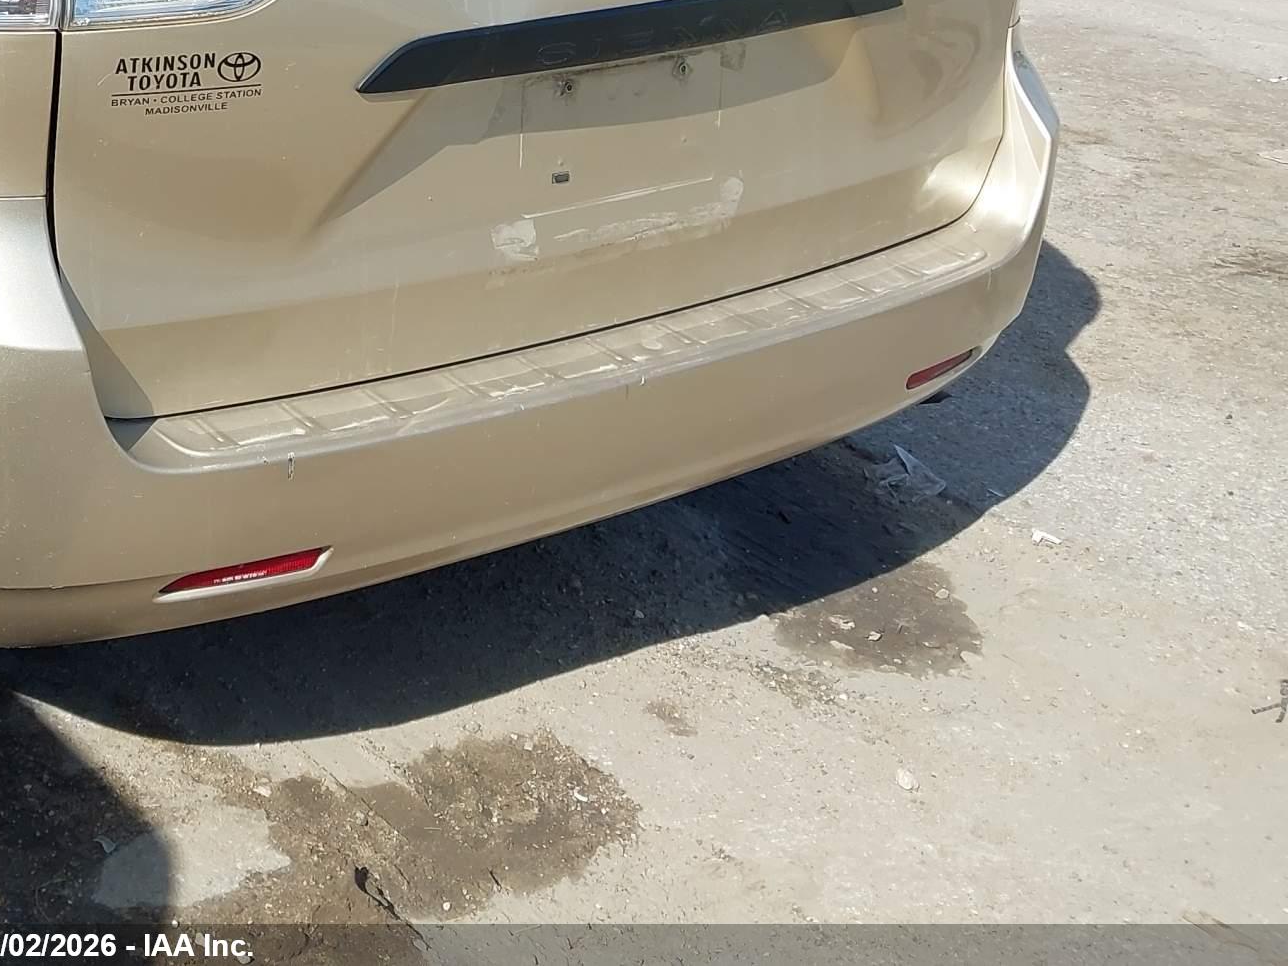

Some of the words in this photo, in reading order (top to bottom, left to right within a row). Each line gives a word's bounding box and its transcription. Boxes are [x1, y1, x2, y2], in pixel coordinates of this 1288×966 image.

[114, 52, 216, 75] ATKINSON
[127, 71, 202, 92] TOYOTA
[111, 97, 151, 107] BRYAN
[160, 92, 213, 104] COLLEGE
[215, 88, 262, 100] STATION
[145, 101, 228, 116] MADISONVILLE
